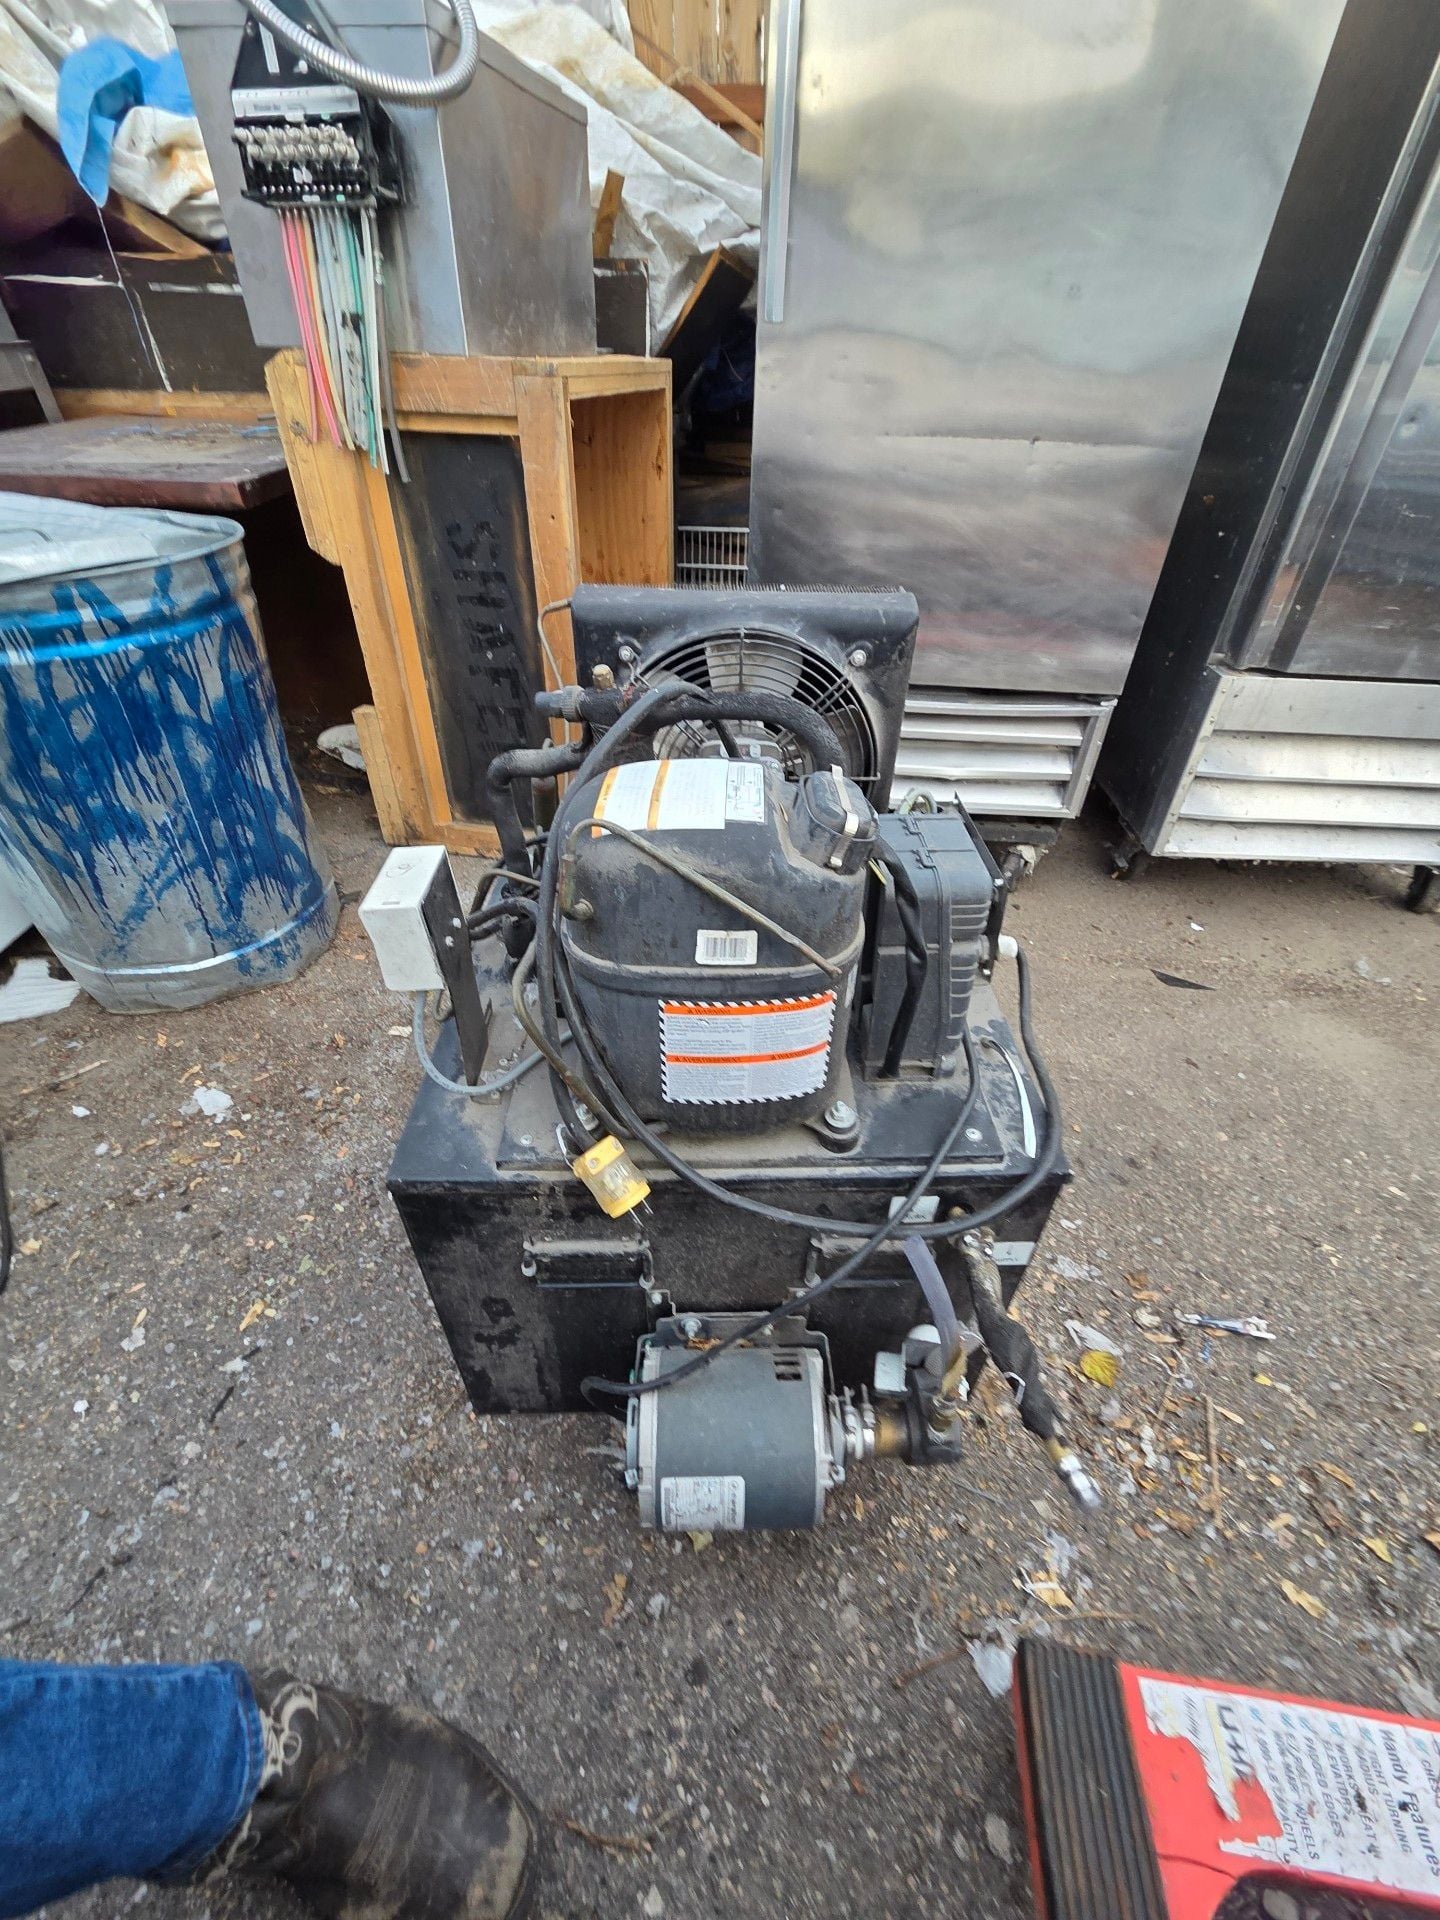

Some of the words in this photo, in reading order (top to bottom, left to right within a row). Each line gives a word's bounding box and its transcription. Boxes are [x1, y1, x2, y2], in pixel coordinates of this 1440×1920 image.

[1303, 1734, 1329, 1790] PADDED
[1322, 1791, 1345, 1839] EDGES
[1321, 1739, 1355, 1817] ELEVATORS
[1335, 1743, 1359, 1793] WORKS
[1353, 1744, 1379, 1796] RADIUS
[1366, 1748, 1389, 1789] TIGHT
[1383, 1791, 1412, 1854] TURNING
[1380, 1728, 1409, 1786] Handy
[1403, 1791, 1440, 1878] Features
[1294, 1803, 1320, 1860] WHEELS
